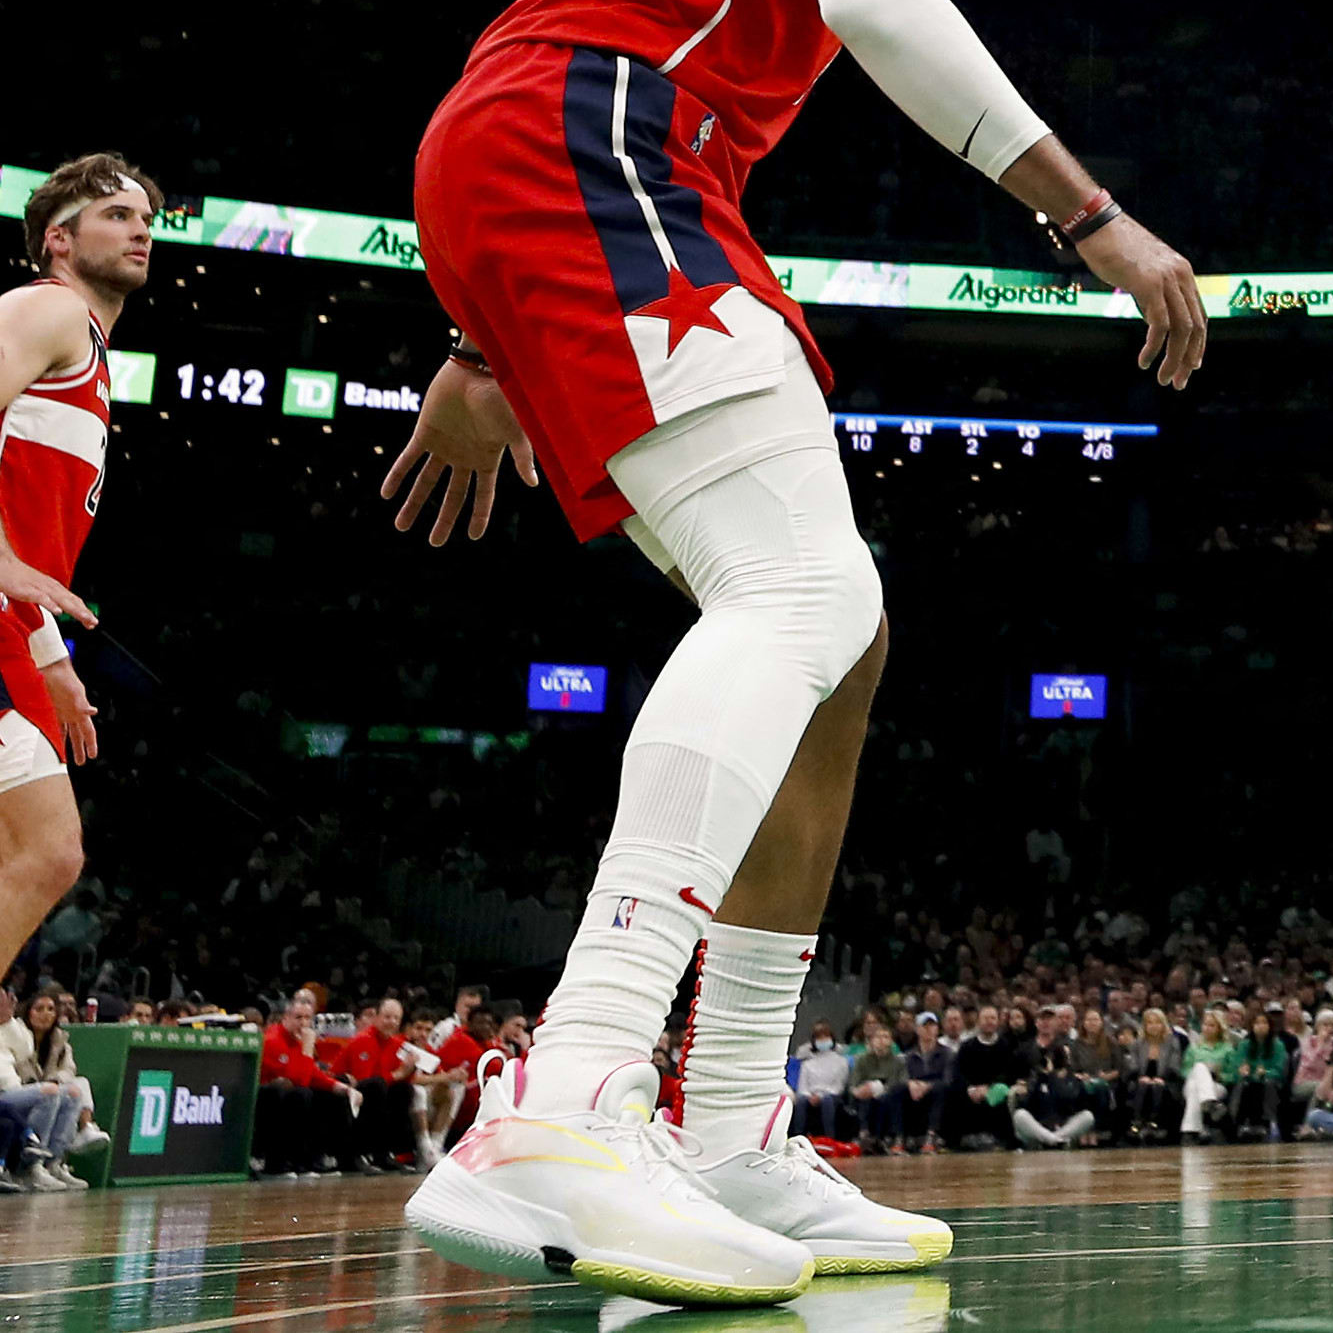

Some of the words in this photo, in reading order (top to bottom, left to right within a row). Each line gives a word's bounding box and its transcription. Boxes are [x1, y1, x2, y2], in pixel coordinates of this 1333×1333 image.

[948, 273, 1078, 308] Algorand
[177, 363, 265, 406] 1:42
[344, 380, 420, 412] Bank
[901, 421, 933, 435] AST
[852, 434, 872, 452] 10
[965, 438, 978, 455] 2
[1021, 441, 1034, 457] 4
[541, 676, 593, 692] ULTRA
[1042, 687, 1093, 700] ULTRA
[173, 1085, 224, 1124] Bank
